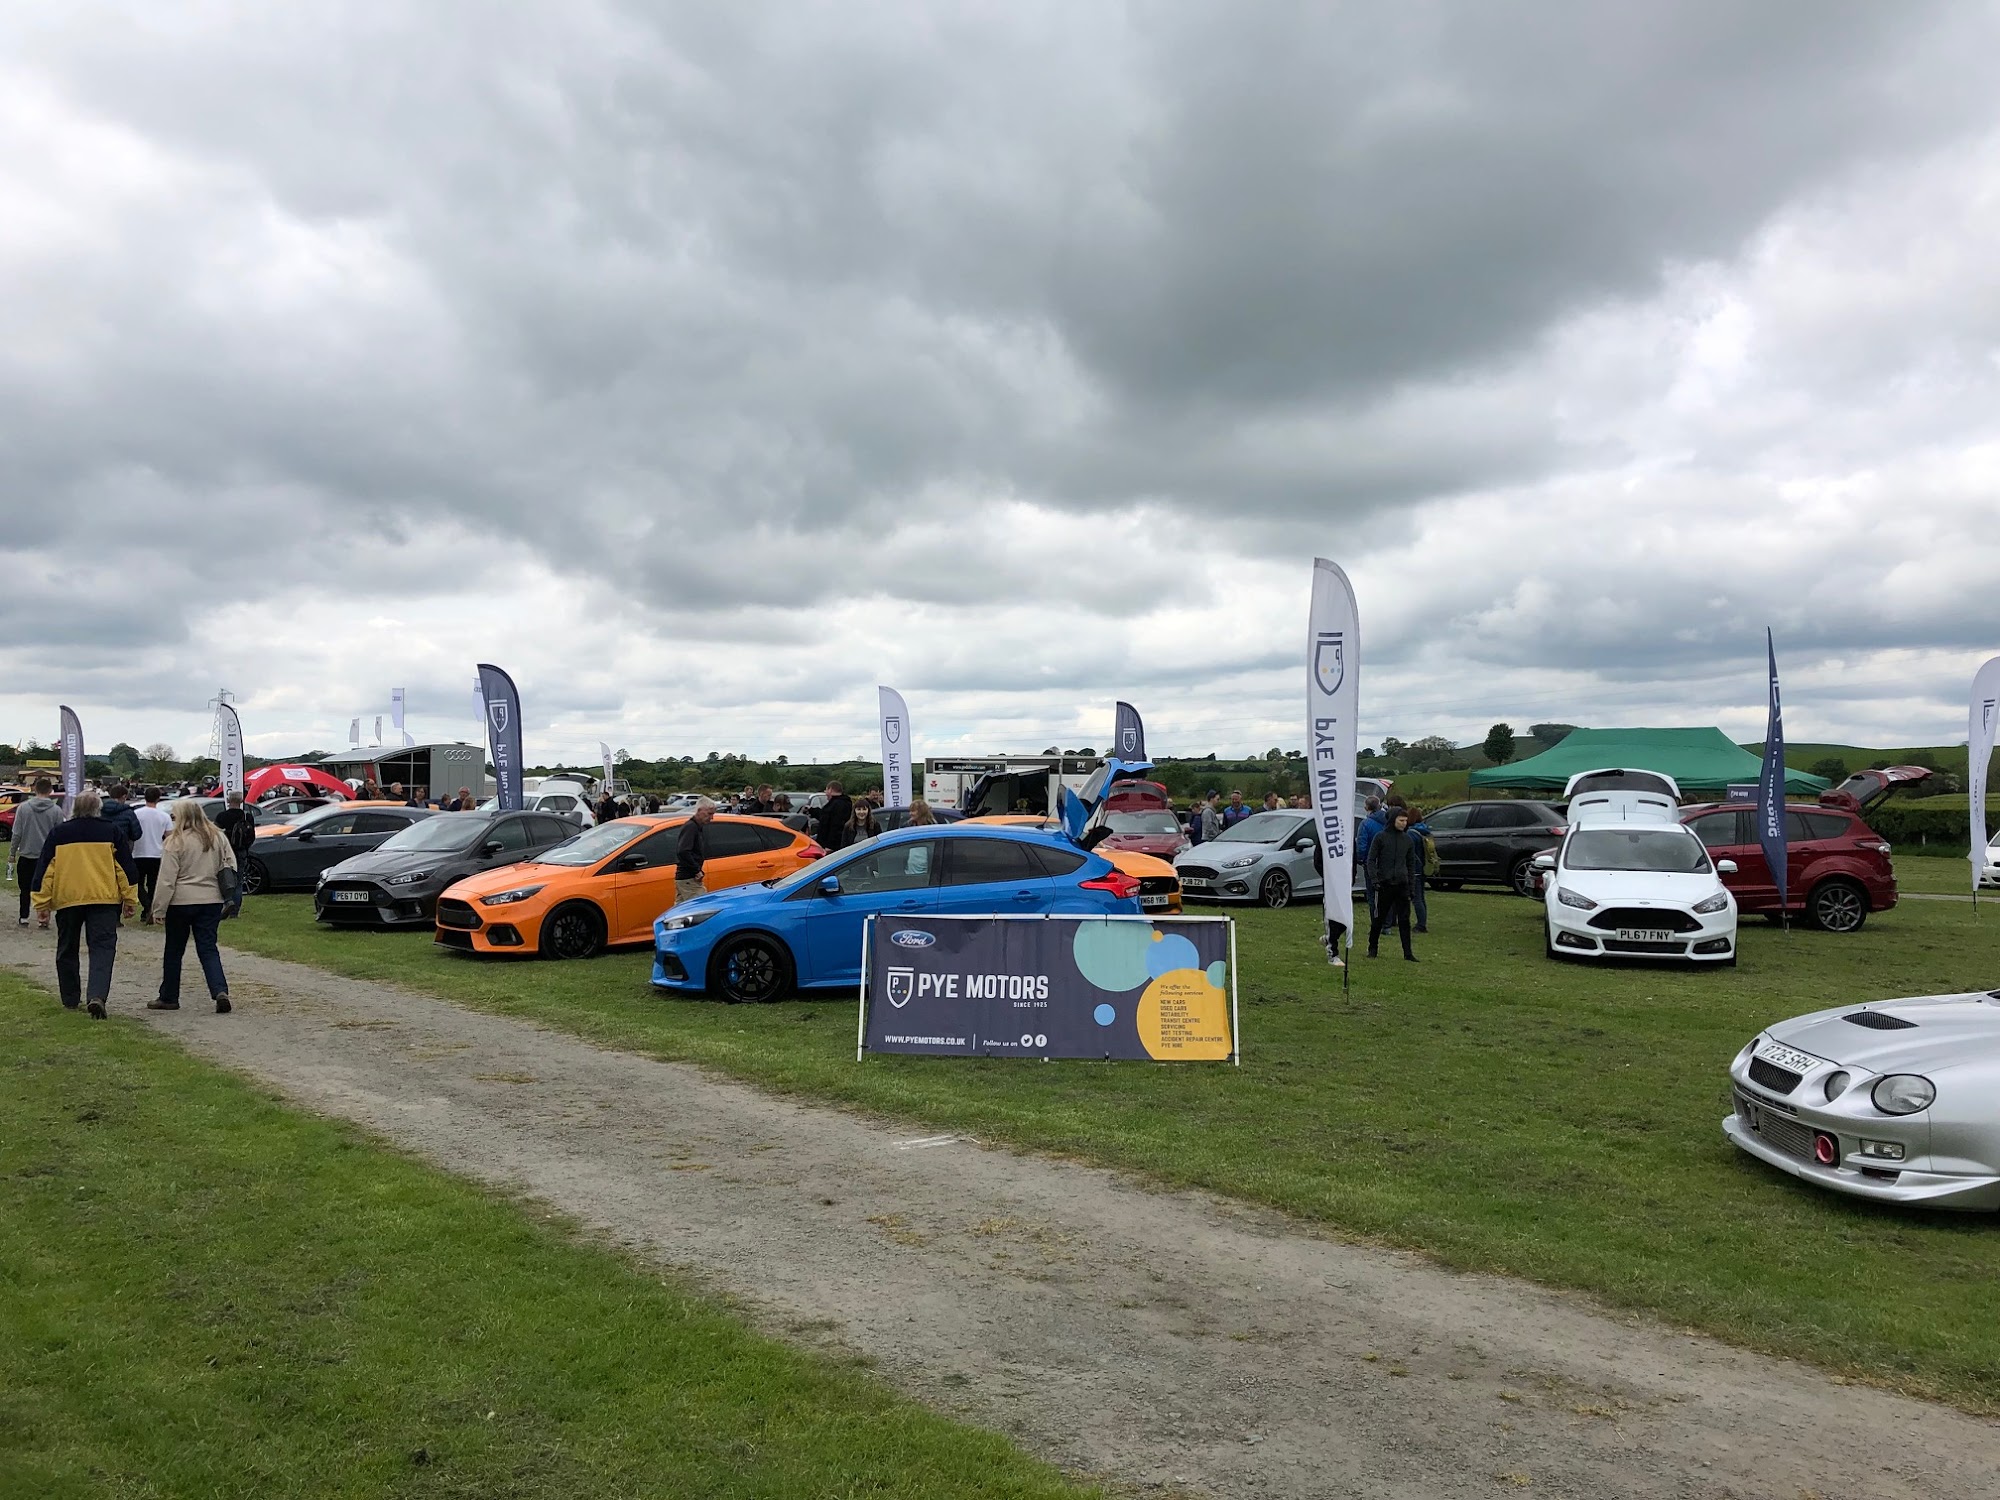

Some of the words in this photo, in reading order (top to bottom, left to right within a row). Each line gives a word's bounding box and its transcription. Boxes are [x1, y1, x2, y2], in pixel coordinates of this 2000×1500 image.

[900, 932, 928, 945] Ford
[1620, 930, 1647, 940] PL67
[1650, 931, 1670, 940] FNY
[918, 973, 959, 998] PYE
[966, 974, 1049, 1000] MOTORS
[884, 1035, 966, 1046] WWW.PYEMOTORS.CO.UK
[1760, 1045, 1792, 1061] R726
[1785, 1054, 1815, 1071] SRH
